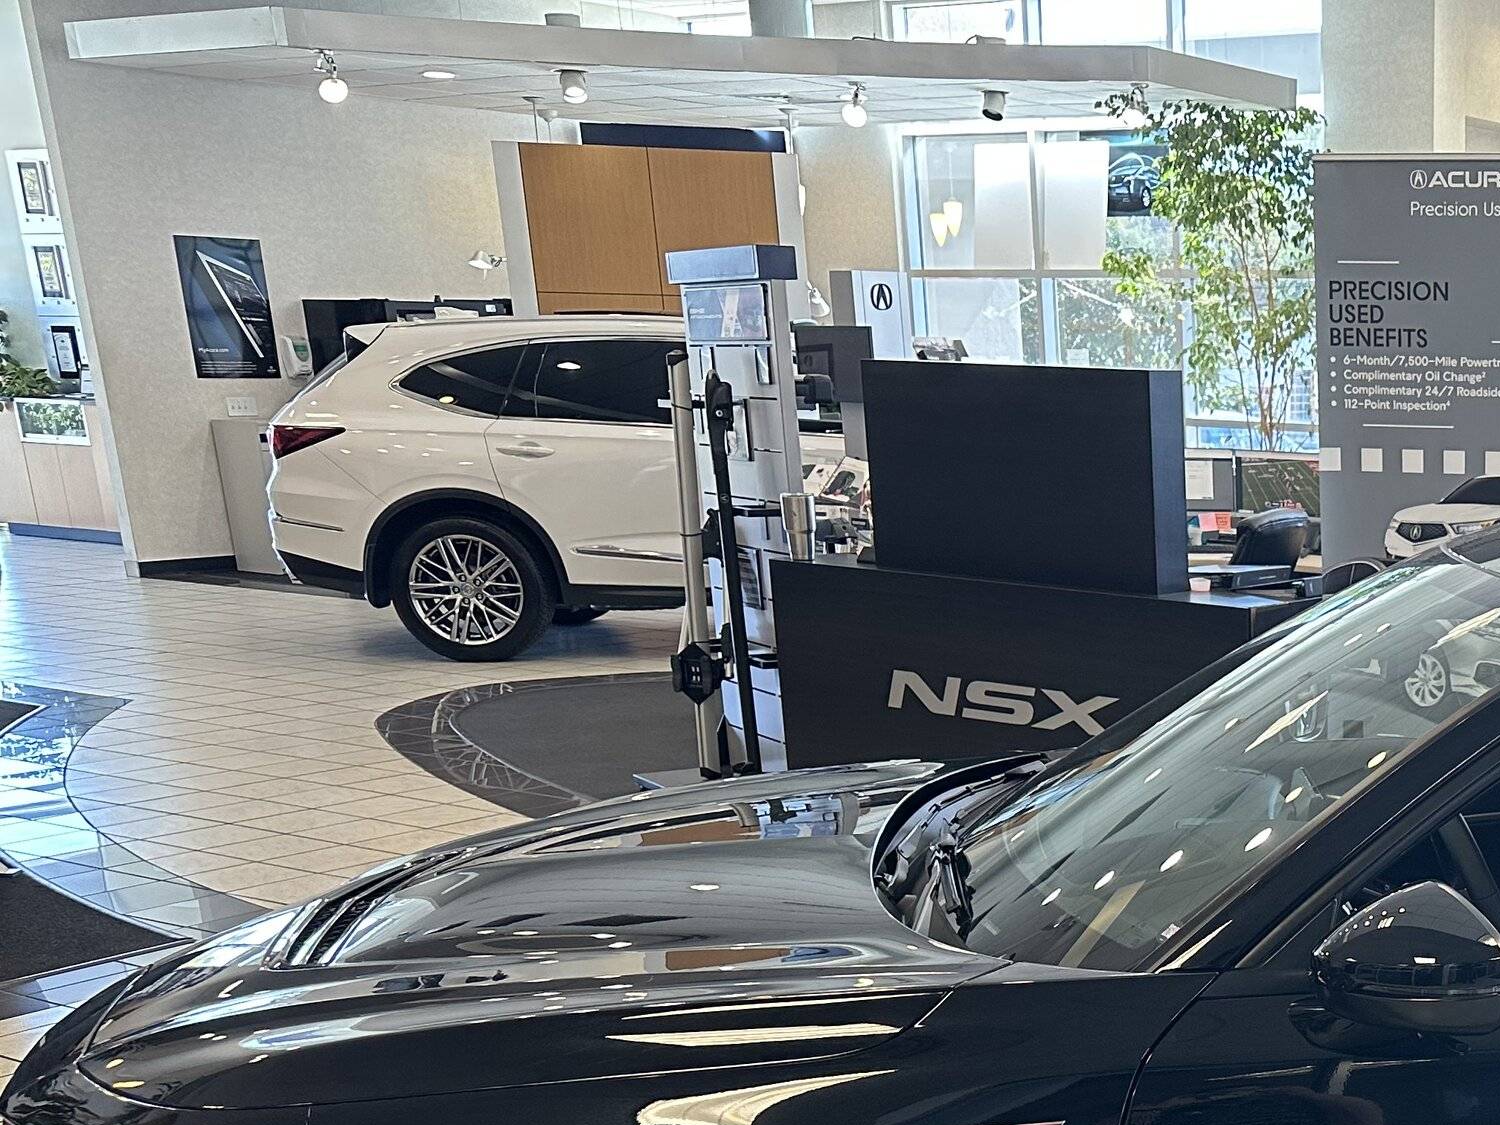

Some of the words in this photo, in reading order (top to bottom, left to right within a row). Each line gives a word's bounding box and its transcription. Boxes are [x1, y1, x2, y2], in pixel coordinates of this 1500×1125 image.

[1410, 201, 1478, 217] Precision
[1328, 280, 1449, 301] PRECISION
[1328, 304, 1384, 324] USED
[1329, 328, 1428, 348] BENEFITS
[1343, 369, 1422, 383] Complimentary
[1425, 370, 1440, 382] Oil
[1343, 383, 1422, 398] Complimentary
[1425, 385, 1454, 397] 24/7
[1344, 398, 1391, 410] 112-Point
[888, 669, 1120, 736] NSX
